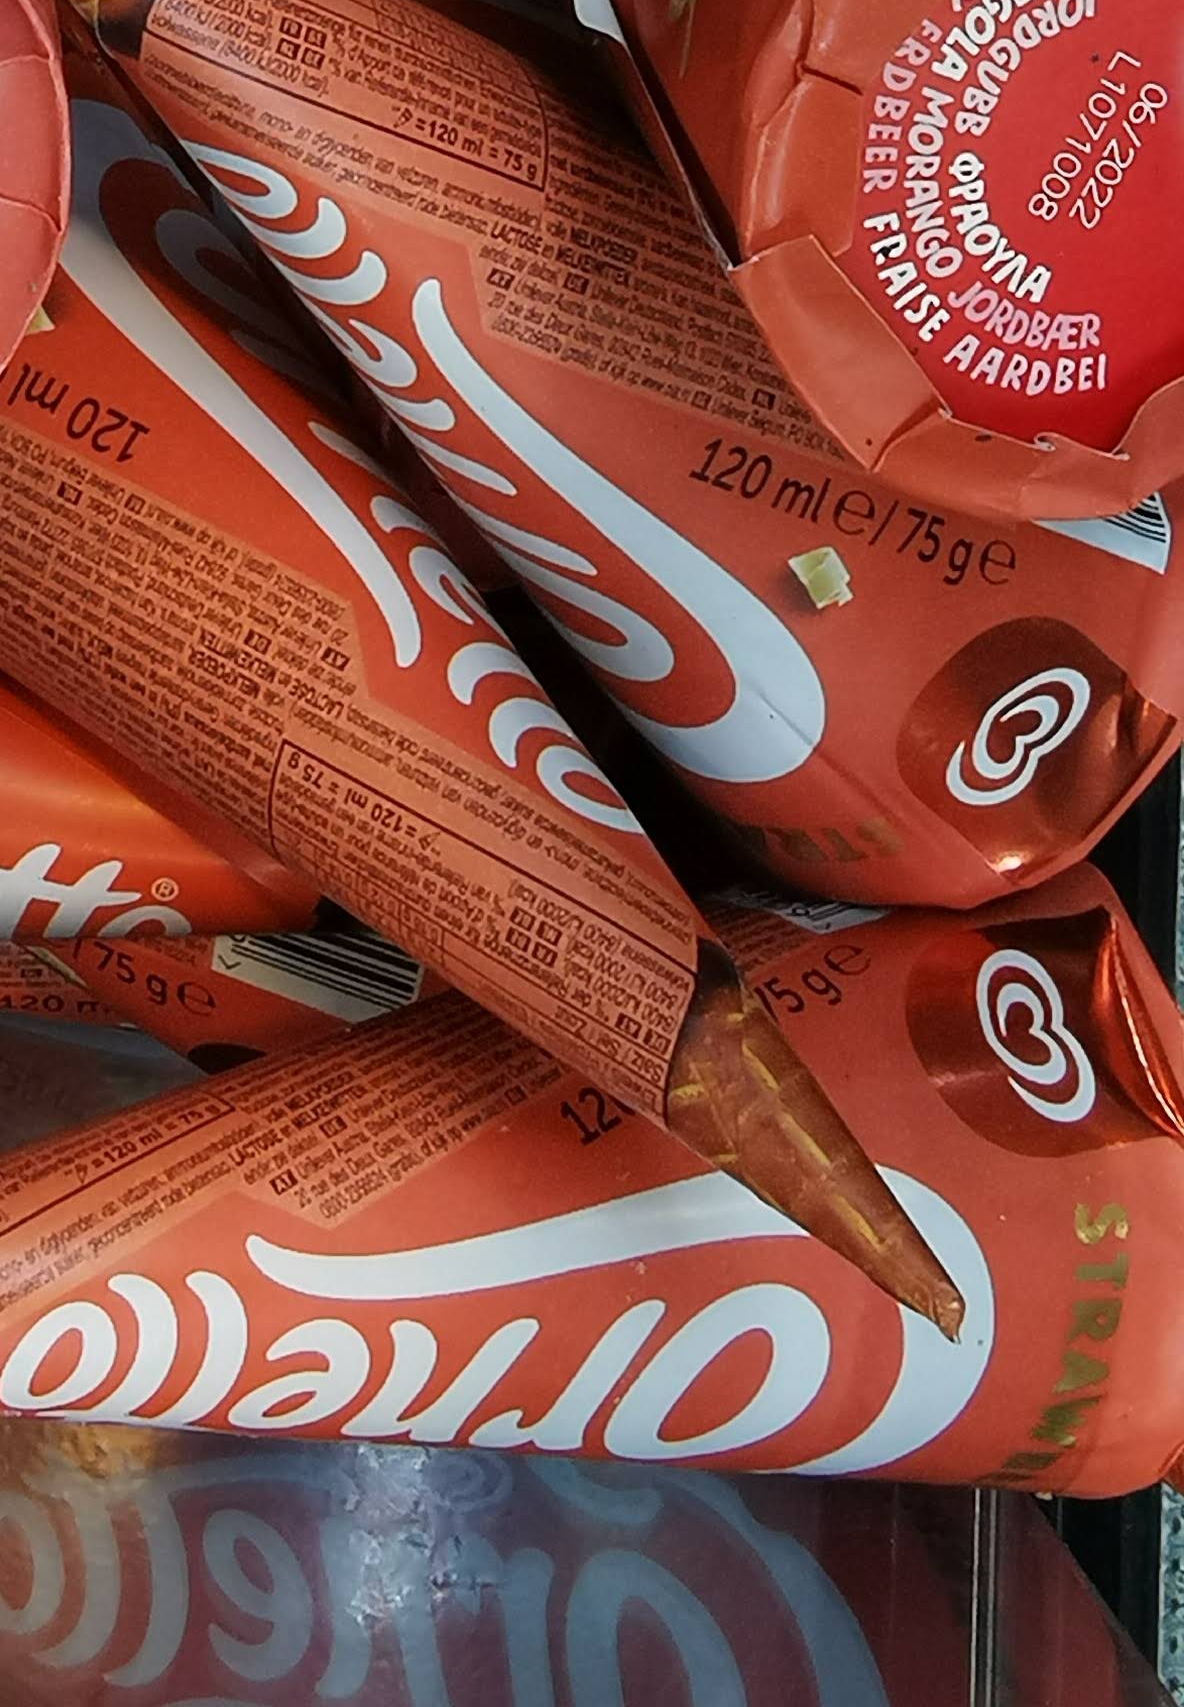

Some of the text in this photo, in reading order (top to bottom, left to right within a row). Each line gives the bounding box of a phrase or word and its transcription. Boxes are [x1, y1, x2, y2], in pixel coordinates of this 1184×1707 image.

[862, 18, 944, 194] ERDBEER
[1027, 50, 1143, 223] L1071008
[1068, 81, 1169, 232] 06/2022
[903, 85, 964, 280] MORANGO
[862, 212, 952, 344] FRAISE
[947, 277, 1103, 351] JORDBÆR
[1, 360, 151, 471] 120 ml
[942, 331, 1108, 398] AARDBEI
[687, 431, 776, 503] 120
[770, 461, 833, 524] ml
[893, 505, 950, 566] 75
[85, 940, 143, 986] 75
